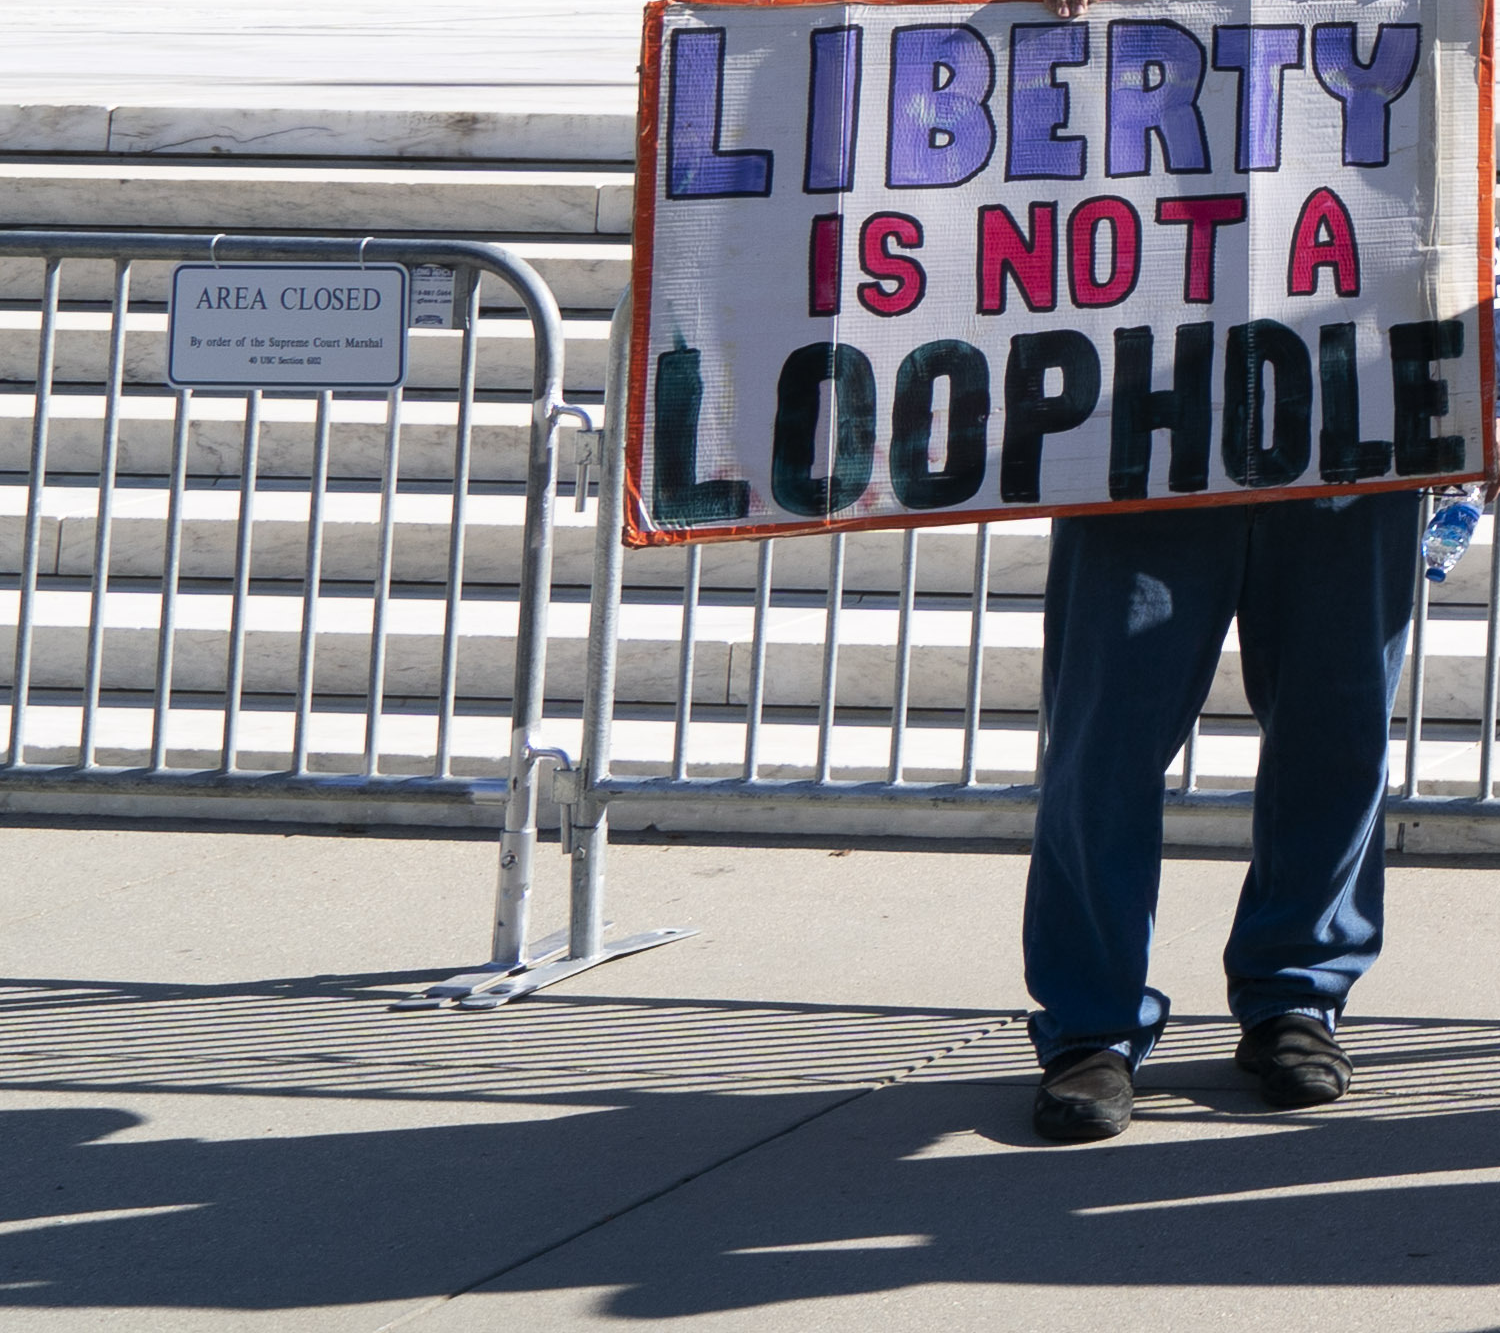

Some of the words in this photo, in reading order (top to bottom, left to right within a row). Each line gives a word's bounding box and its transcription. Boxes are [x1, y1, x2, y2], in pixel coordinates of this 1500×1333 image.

[666, 17, 1422, 200] LIBERTY
[808, 211, 927, 317] IS
[976, 191, 1247, 315] NOT
[1287, 186, 1360, 298] A
[196, 286, 268, 310] AREA
[280, 287, 382, 311] CLOSED
[190, 336, 202, 348] By
[206, 337, 231, 348] order
[235, 336, 247, 347] of
[250, 336, 265, 347] the
[268, 337, 310, 350] Supreme
[313, 337, 341, 348] Court
[344, 337, 384, 349] Marshal
[278, 356, 304, 365] Section
[652, 318, 1465, 524] LOOPHOLE
